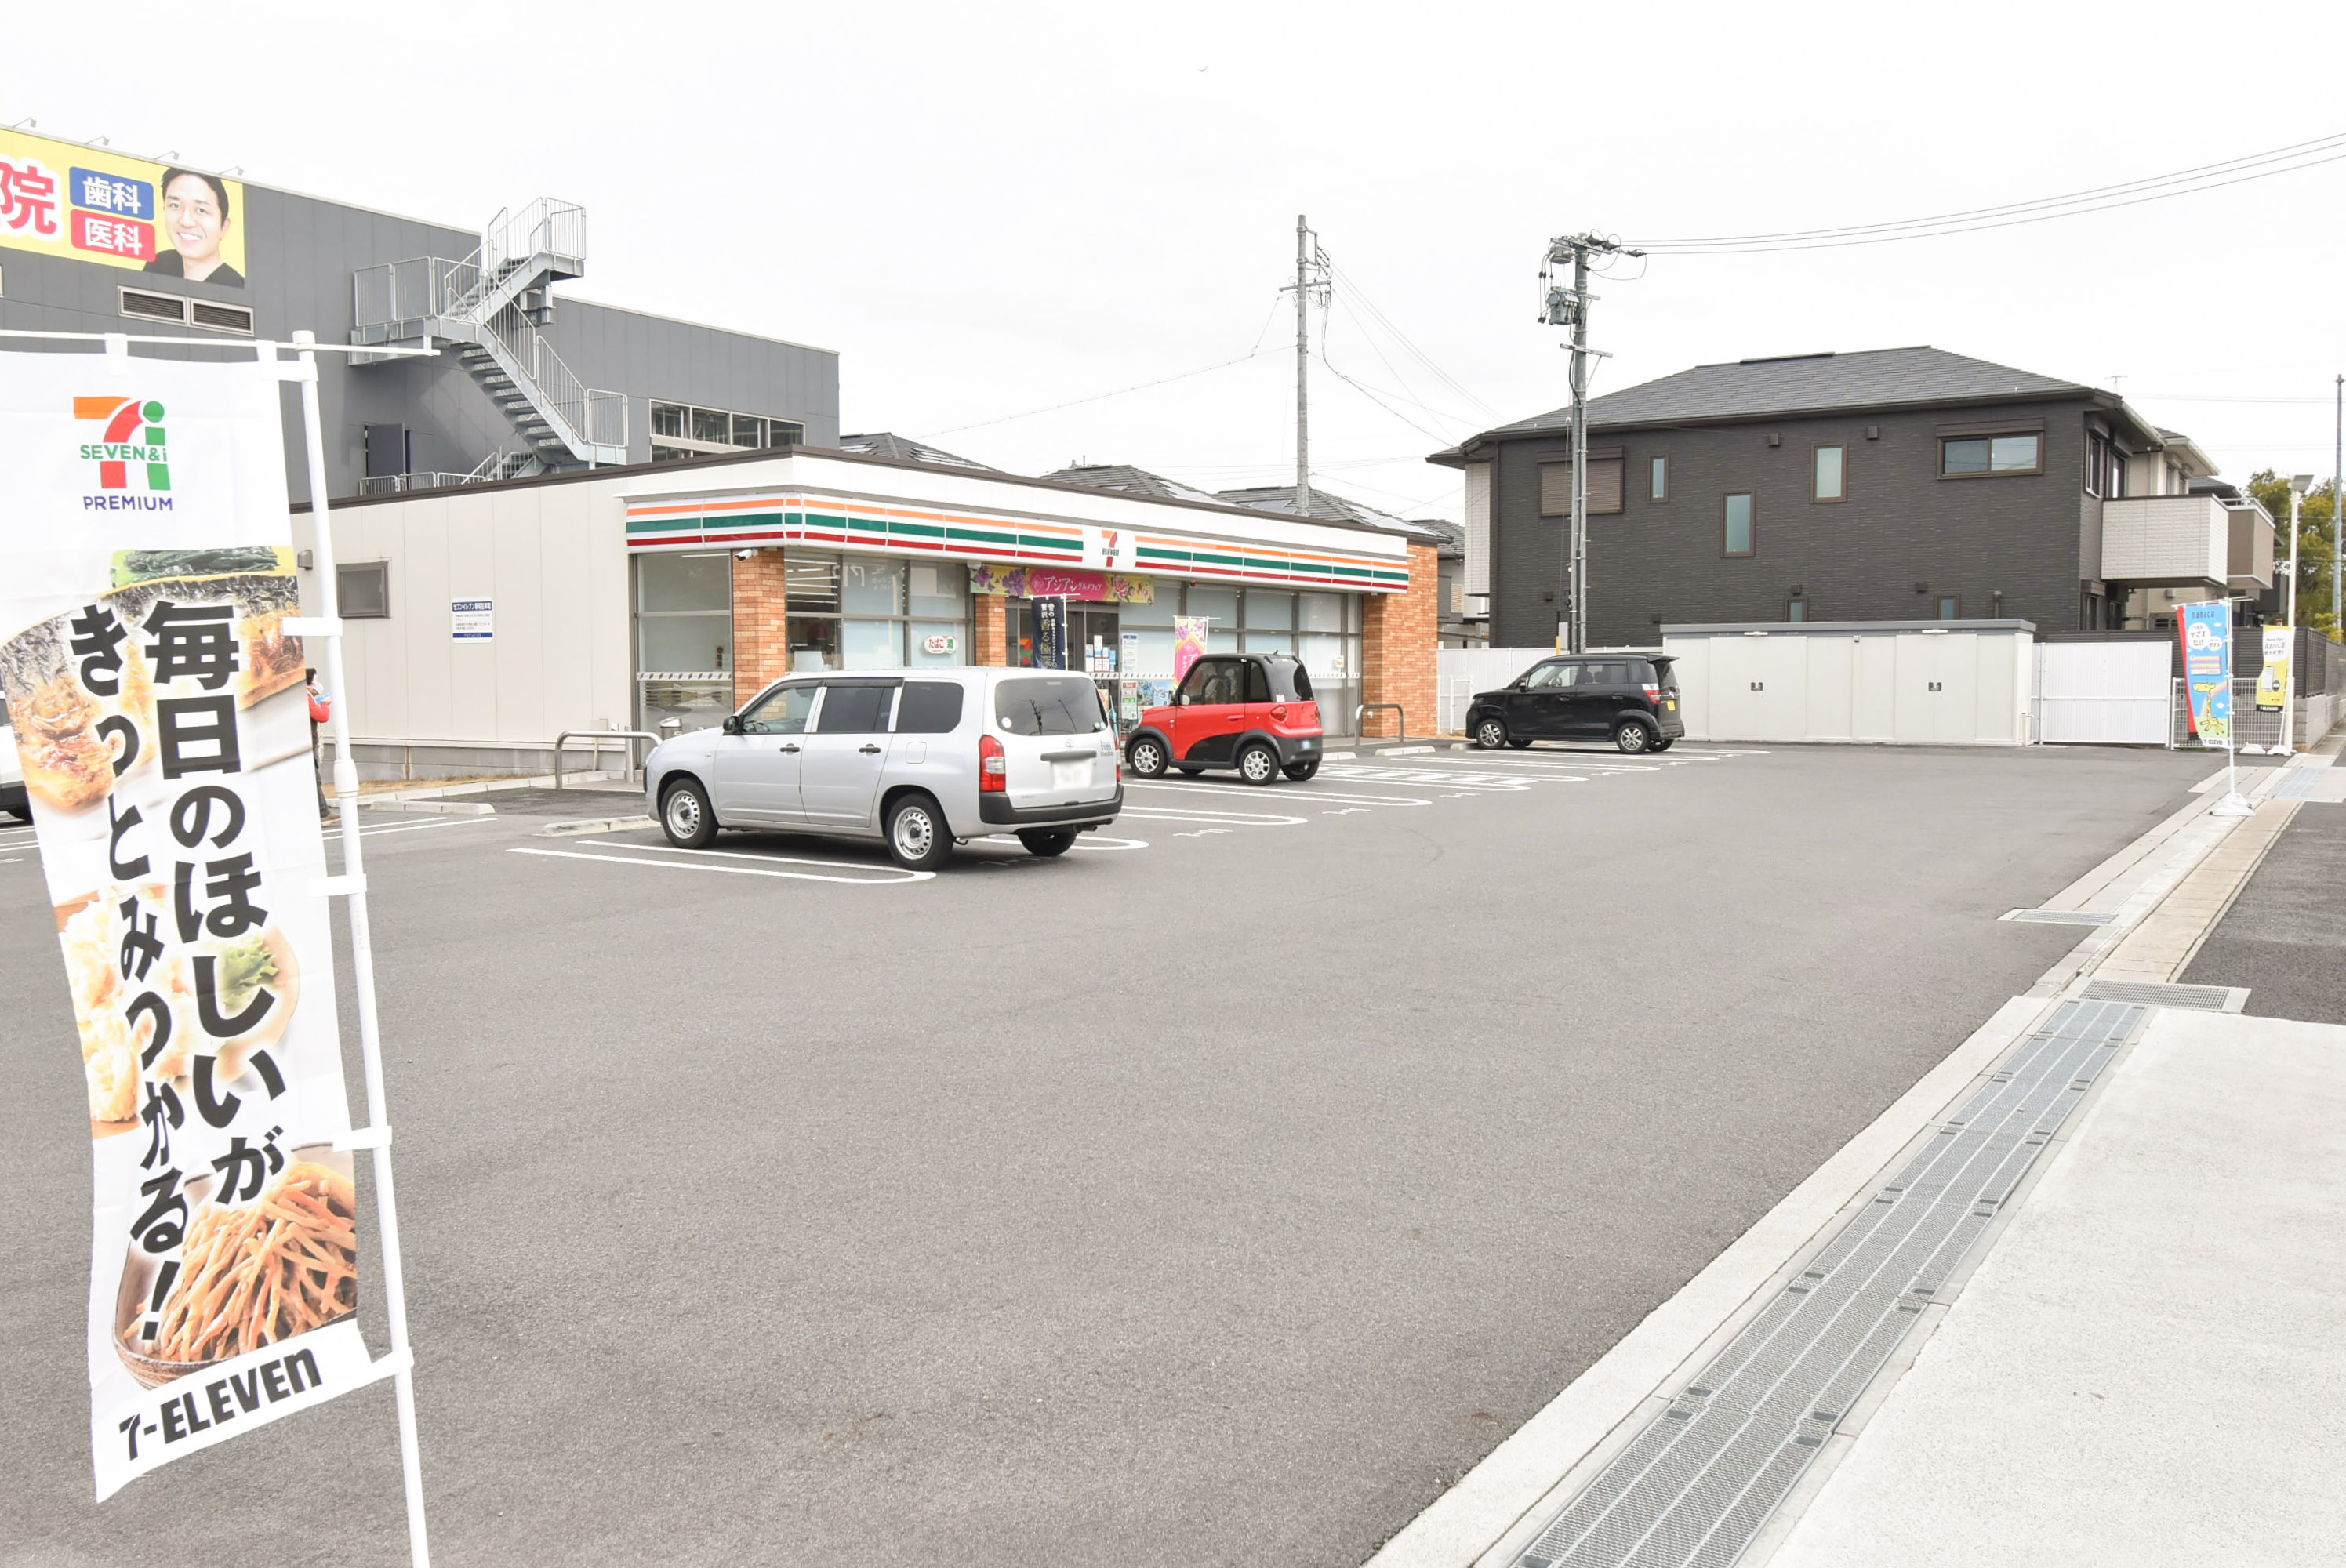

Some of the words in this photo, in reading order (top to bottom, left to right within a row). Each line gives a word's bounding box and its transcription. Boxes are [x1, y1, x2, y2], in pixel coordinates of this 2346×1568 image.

[83, 176, 142, 215] 歯科
[85, 216, 143, 255] 医科
[82, 495, 173, 511] PREMIUM
[143, 600, 287, 1205] 毎日のほしいが
[69, 604, 189, 1341] きっとみつかる!
